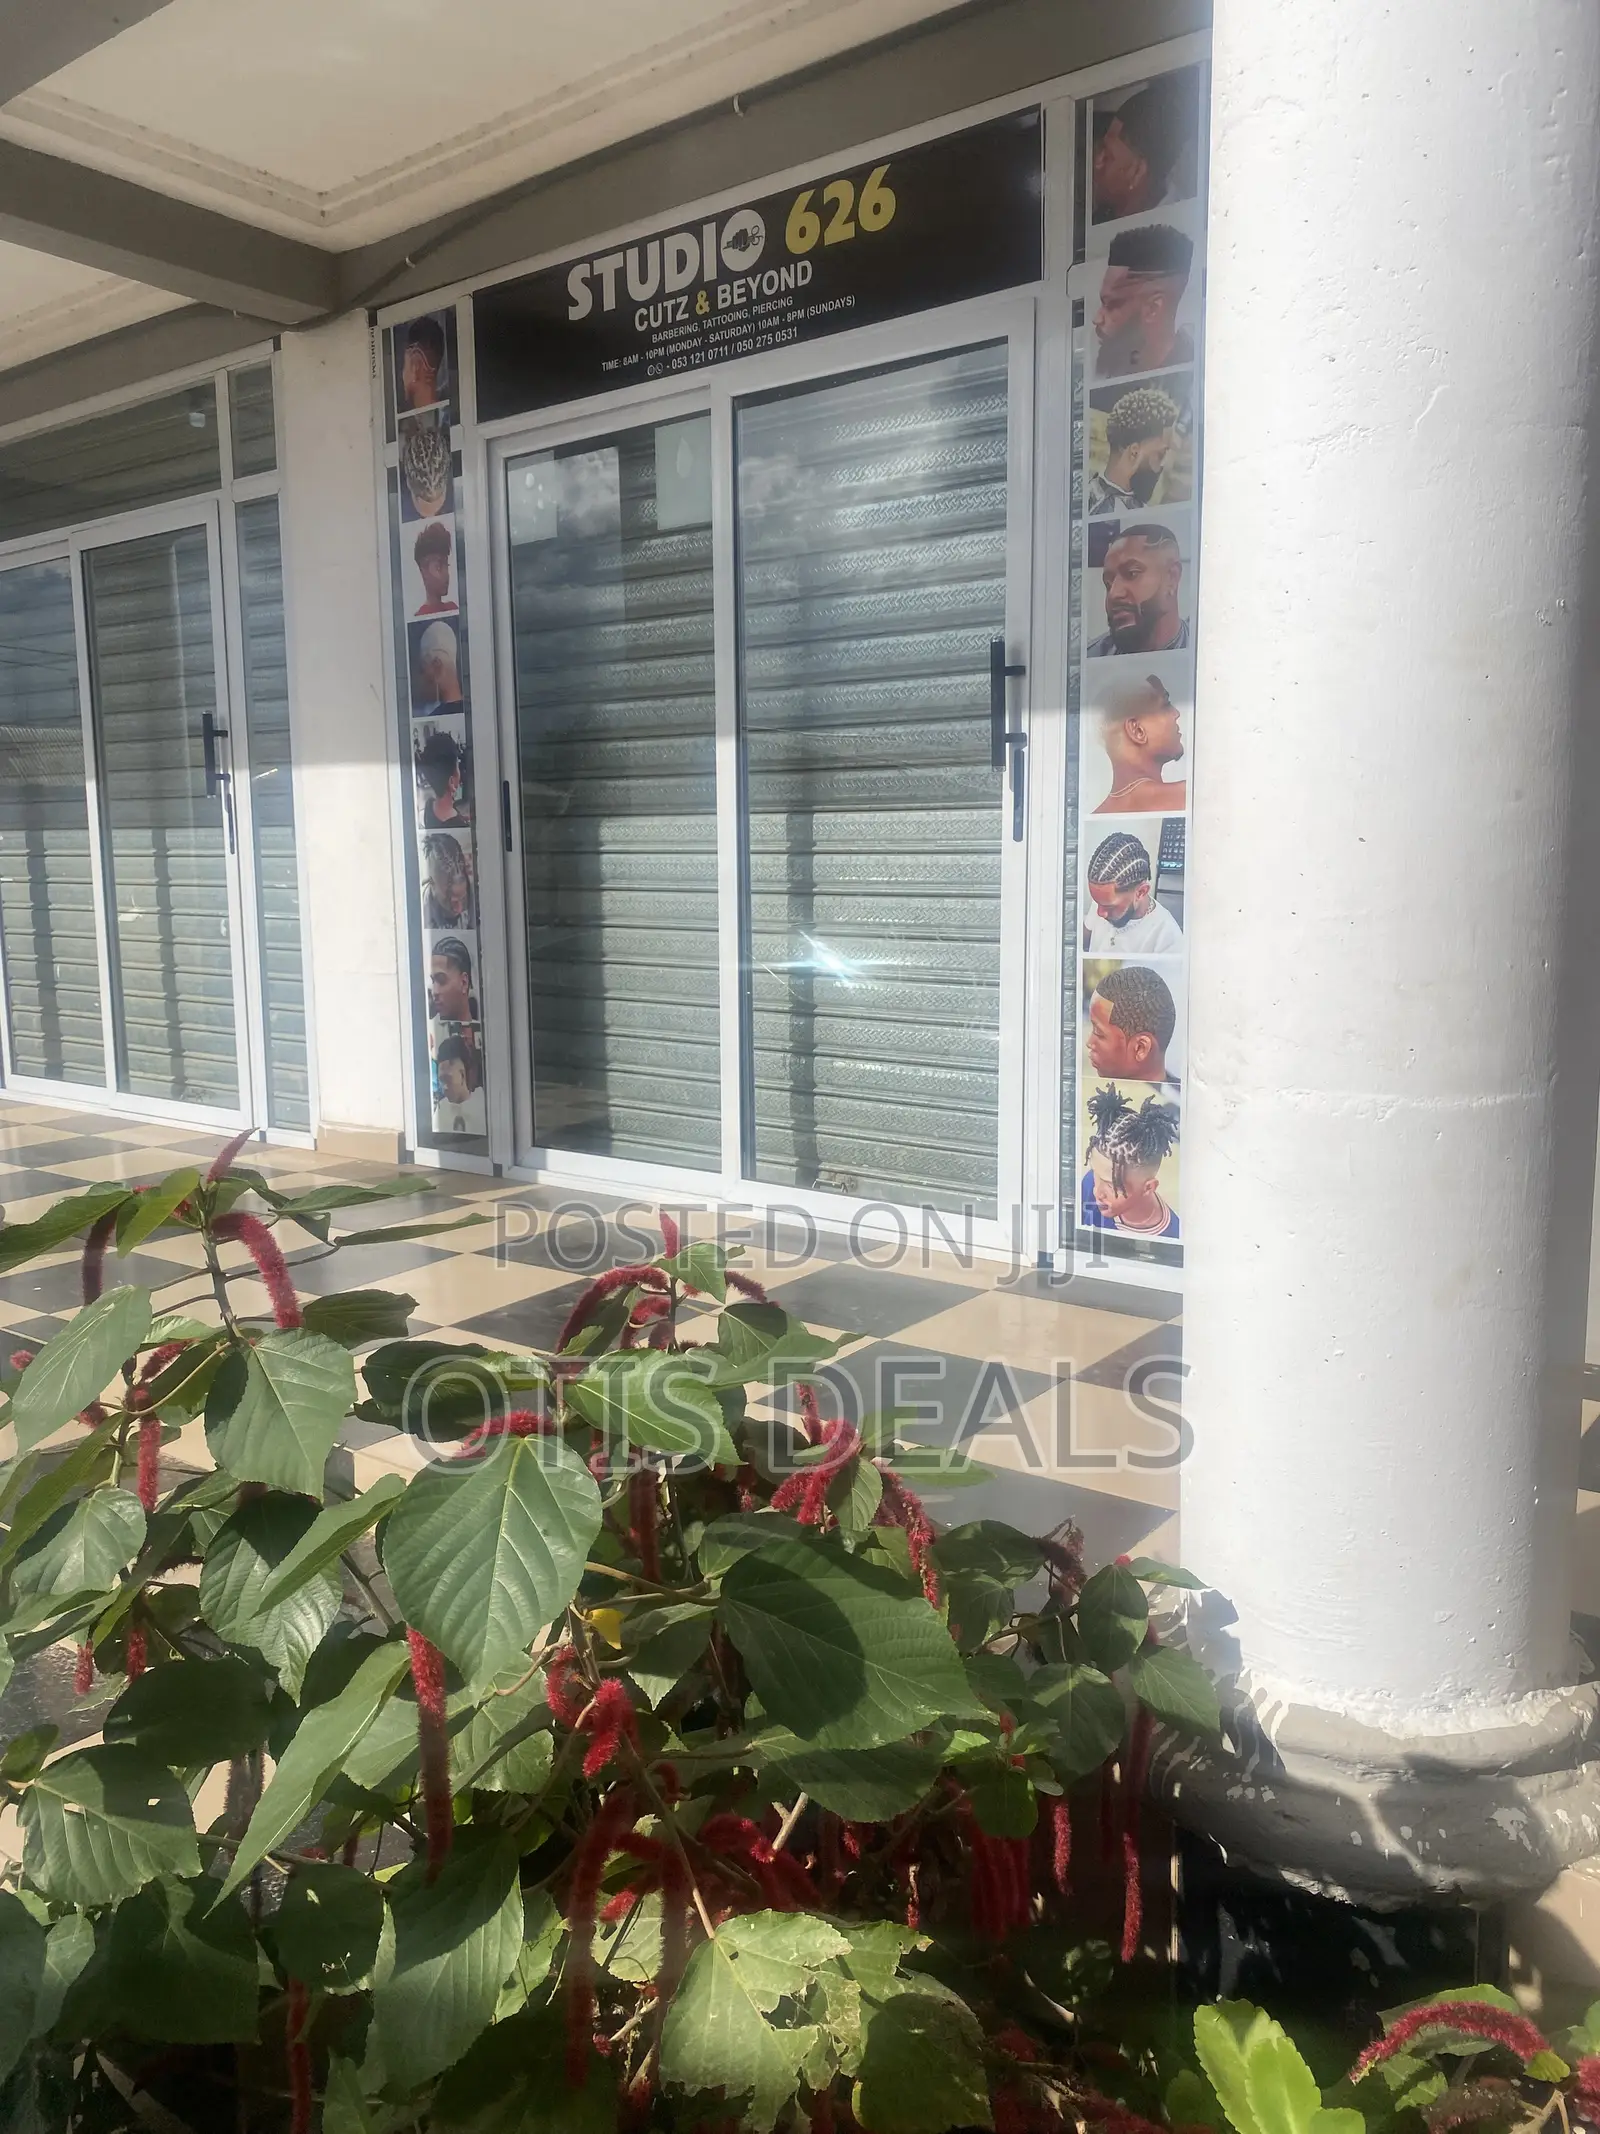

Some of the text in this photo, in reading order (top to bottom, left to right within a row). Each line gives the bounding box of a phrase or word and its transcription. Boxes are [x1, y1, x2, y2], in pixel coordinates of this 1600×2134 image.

[567, 164, 896, 320] STUDIO 626
[635, 260, 812, 331] CUTZ & BEYOND
[652, 296, 793, 343] BARBERING, TATTOOING, PIERCING
[602, 358, 622, 371] TIME:
[623, 354, 639, 364] 8AM
[645, 347, 665, 361] 10PM
[666, 337, 702, 357] (MONDAY
[709, 323, 756, 343] SATURDAY)
[758, 316, 780, 330] 10AM
[786, 309, 805, 322] 8PM
[807, 295, 856, 319] (SUNDAYS)
[671, 356, 688, 370] 053
[690, 351, 705, 365] 121
[707, 345, 728, 360] 0711
[737, 338, 753, 353] 050
[756, 333, 773, 347] 275
[775, 326, 798, 343] 0531
